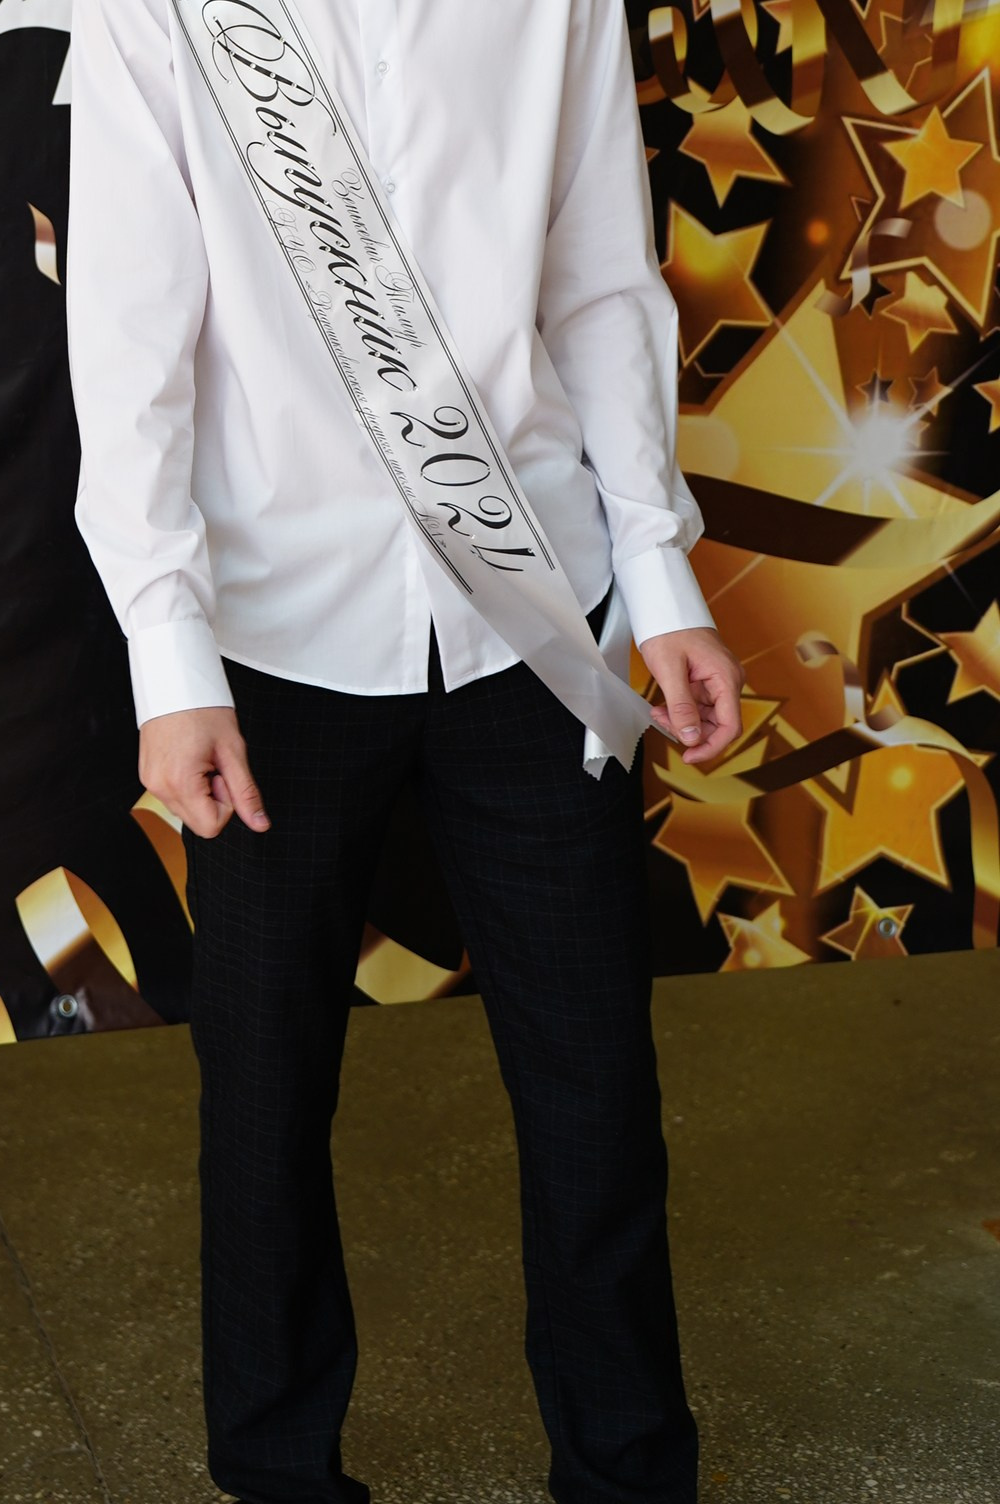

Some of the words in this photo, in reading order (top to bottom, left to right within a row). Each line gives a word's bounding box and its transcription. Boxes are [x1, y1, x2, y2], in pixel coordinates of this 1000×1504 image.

[331, 167, 391, 264] Зенькевич
[374, 264, 428, 350] Тимур
[355, 406, 393, 455] средняя
[389, 459, 416, 498] школа
[390, 405, 536, 573] 2024
